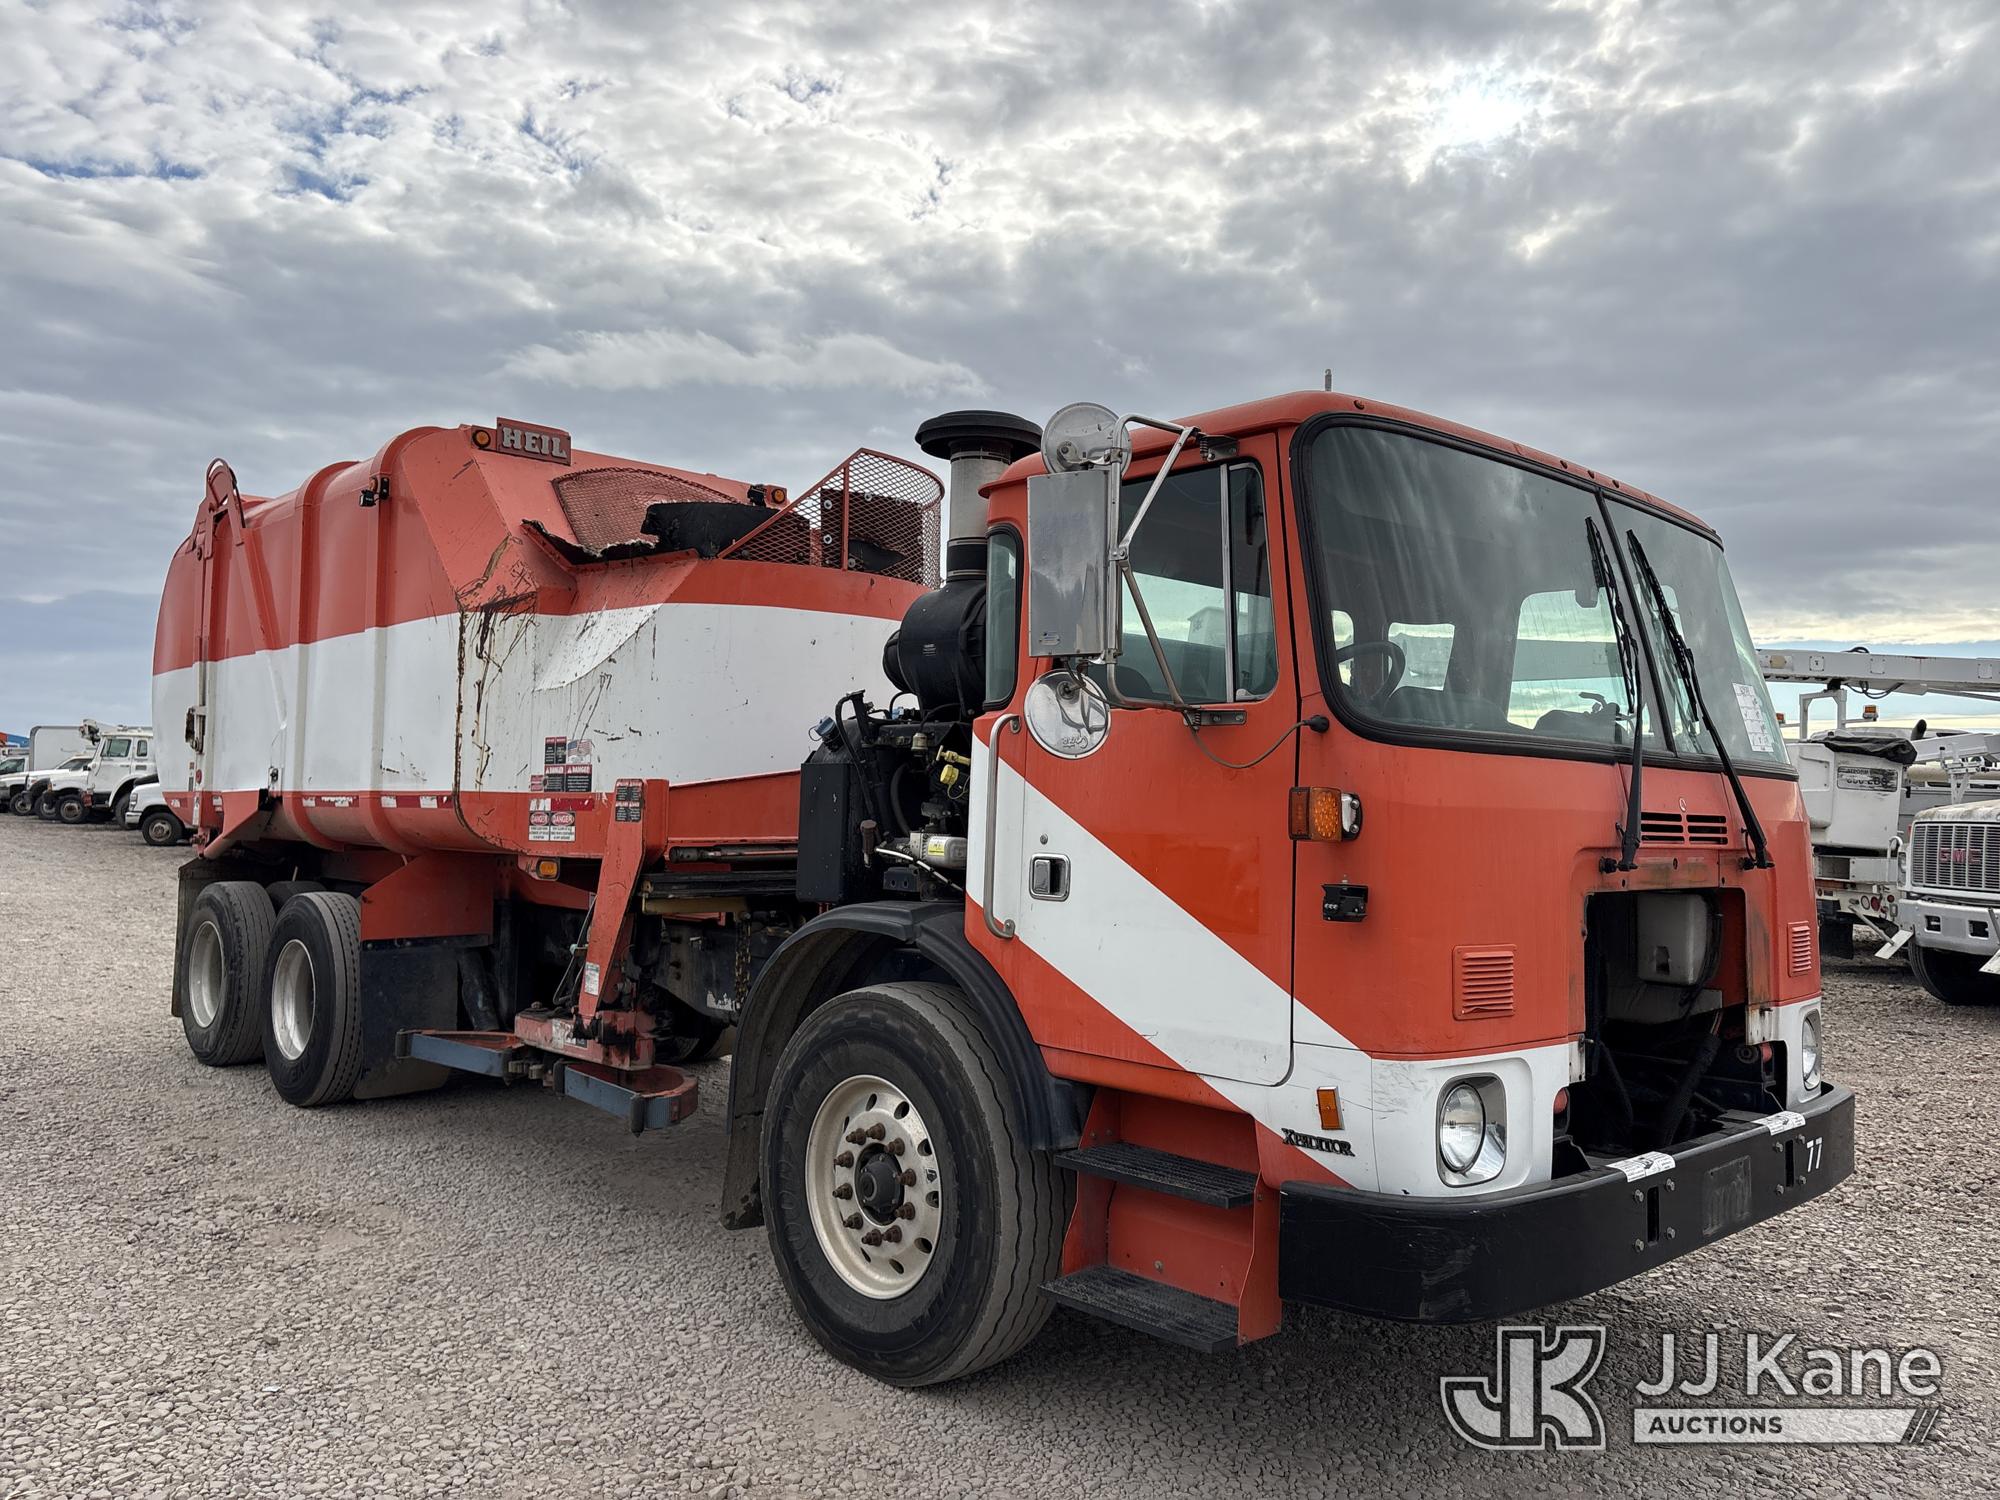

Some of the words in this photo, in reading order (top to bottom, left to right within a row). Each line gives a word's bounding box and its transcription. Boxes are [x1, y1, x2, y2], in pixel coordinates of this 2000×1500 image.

[502, 427, 567, 458] HEIL
[1939, 848, 1981, 864] GMC
[1806, 1137, 1823, 1172] 77
